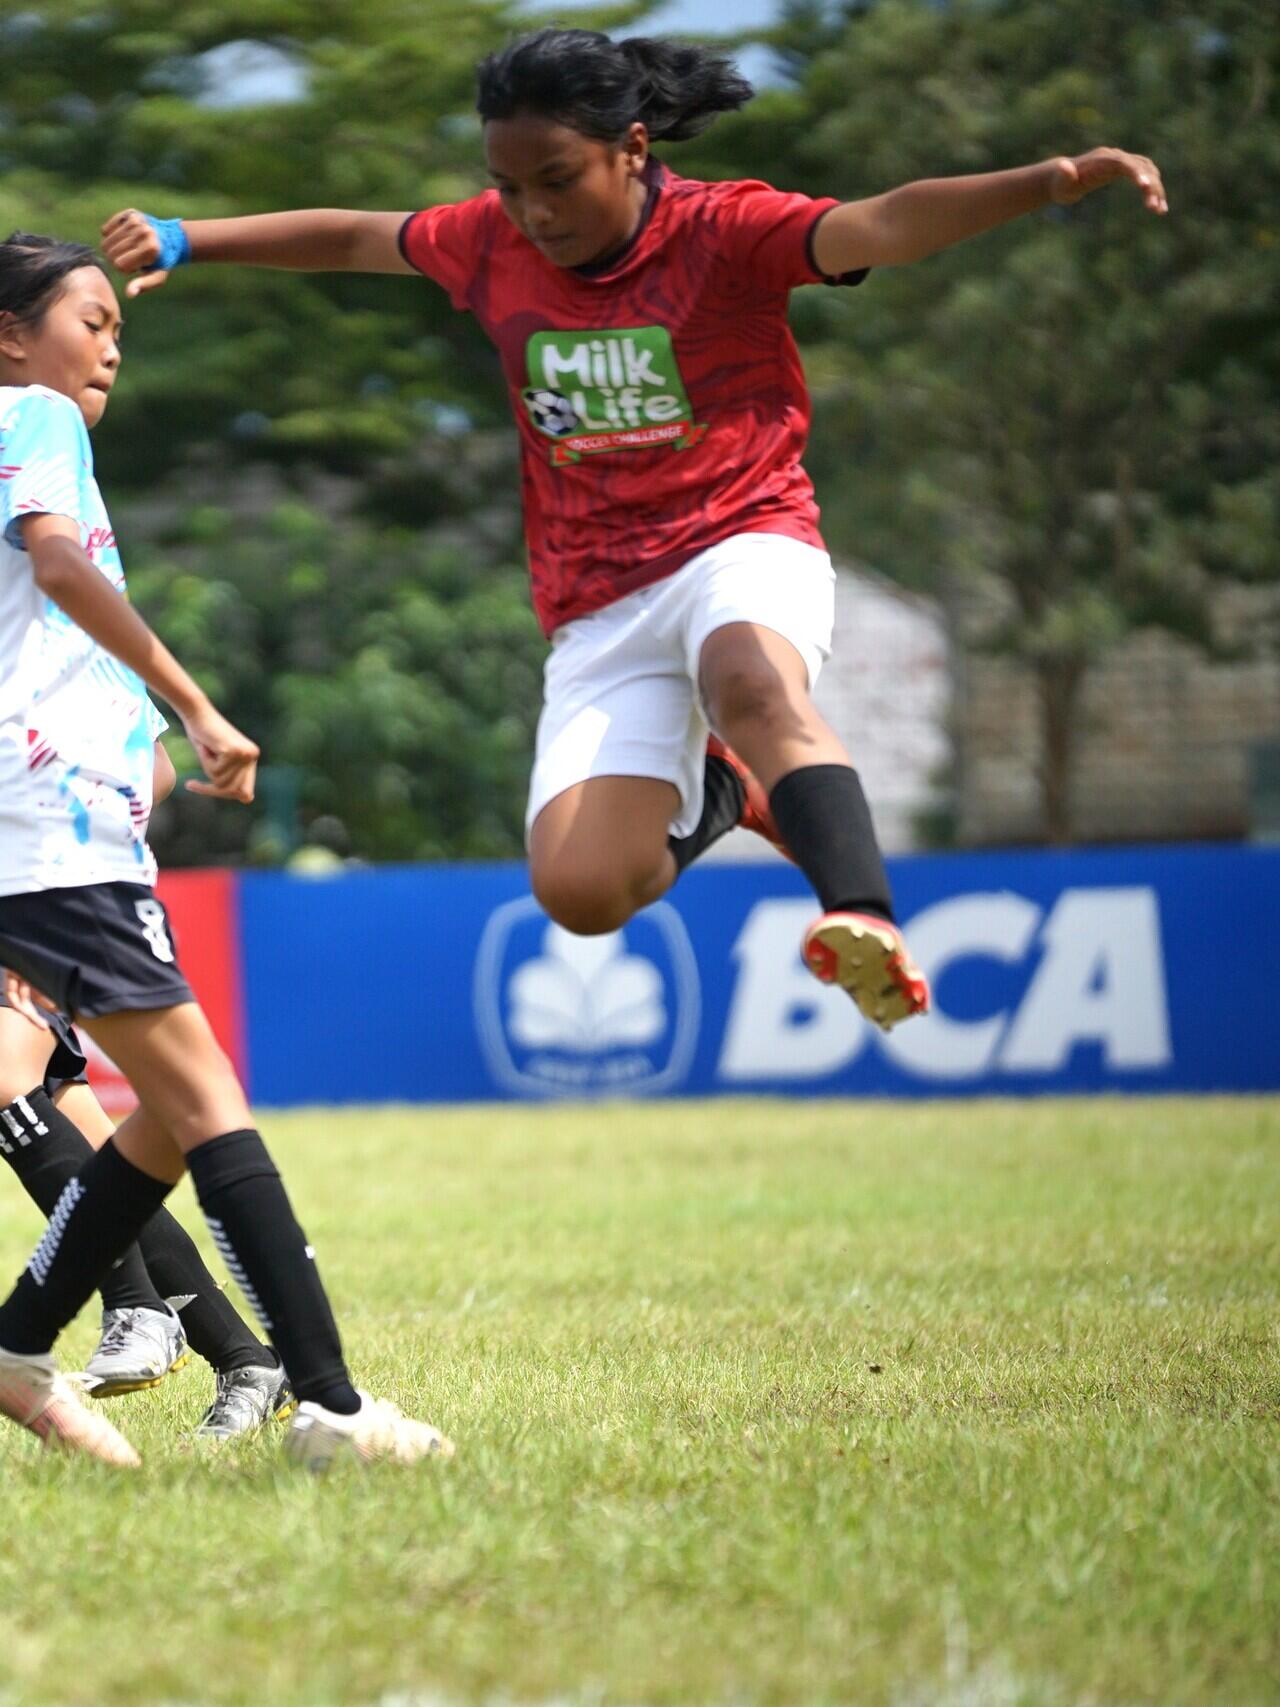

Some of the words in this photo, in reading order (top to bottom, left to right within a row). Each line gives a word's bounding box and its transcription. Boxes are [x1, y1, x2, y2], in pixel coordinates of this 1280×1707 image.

[541, 337, 666, 388] Milk
[572, 388, 683, 430] Life
[611, 425, 685, 445] CHALLENGE
[133, 898, 175, 963] 8
[718, 886, 1173, 1080] BCA
